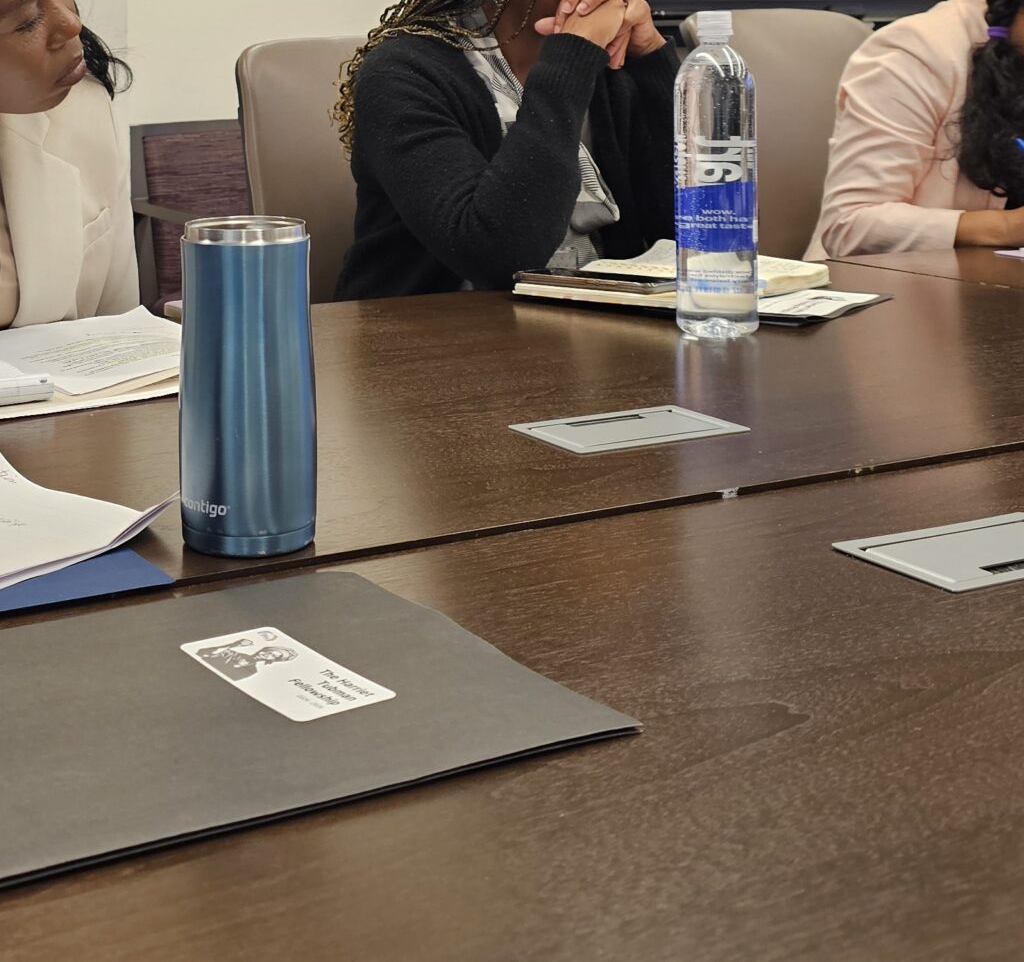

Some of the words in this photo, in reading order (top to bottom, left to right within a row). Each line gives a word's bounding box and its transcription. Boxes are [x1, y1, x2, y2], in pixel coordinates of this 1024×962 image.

[695, 214, 727, 222] both
[288, 678, 340, 705] Fellowship
[317, 680, 356, 701] Tubman
[320, 669, 339, 680] The
[341, 678, 375, 697] Harriet
